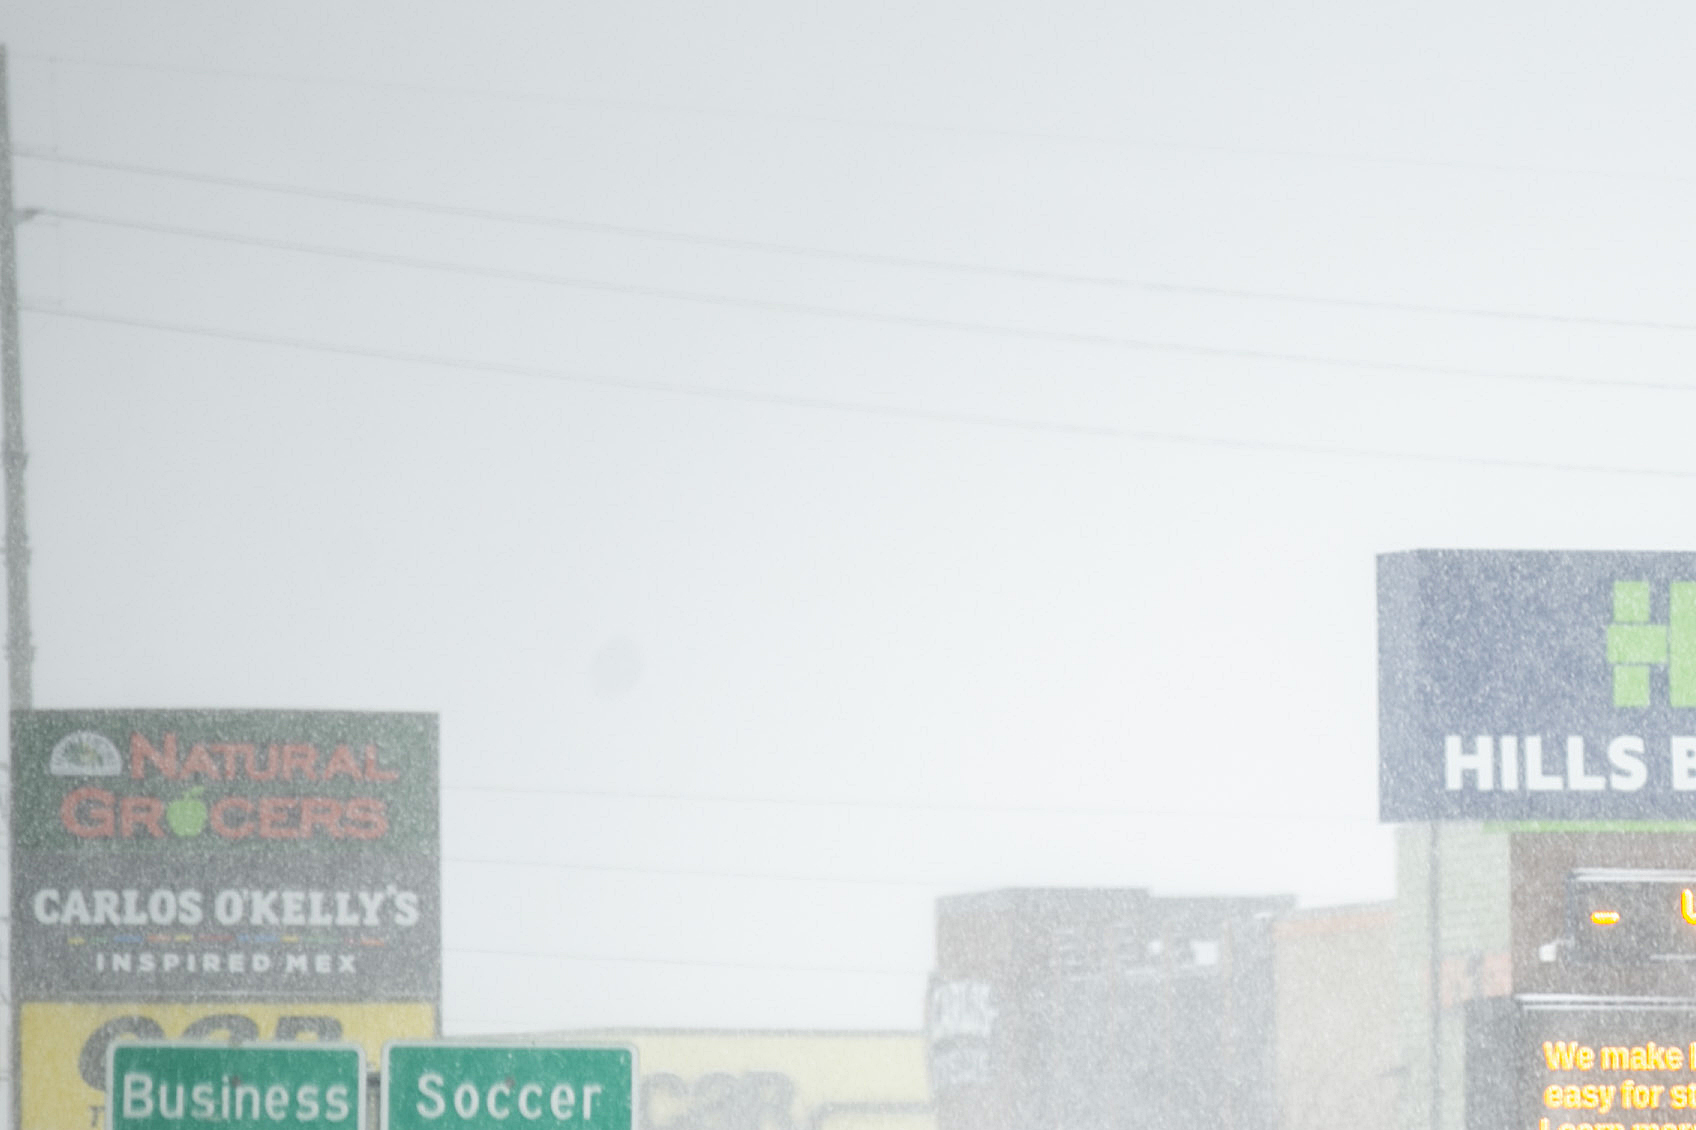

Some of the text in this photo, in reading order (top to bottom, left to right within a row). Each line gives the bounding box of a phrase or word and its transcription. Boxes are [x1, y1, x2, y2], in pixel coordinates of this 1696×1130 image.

[130, 730, 399, 782] NATURAL
[1445, 735, 1647, 791] HILLS
[33, 885, 420, 926] CARLOS O'KELLY'S
[97, 953, 357, 974] INSPIRED MEX
[1543, 1041, 1594, 1070] We
[1601, 1041, 1683, 1070] make
[122, 1074, 350, 1121] Business
[416, 1074, 602, 1121] Soccer
[1544, 1086, 1615, 1114] easy
[1621, 1080, 1665, 1108] for
